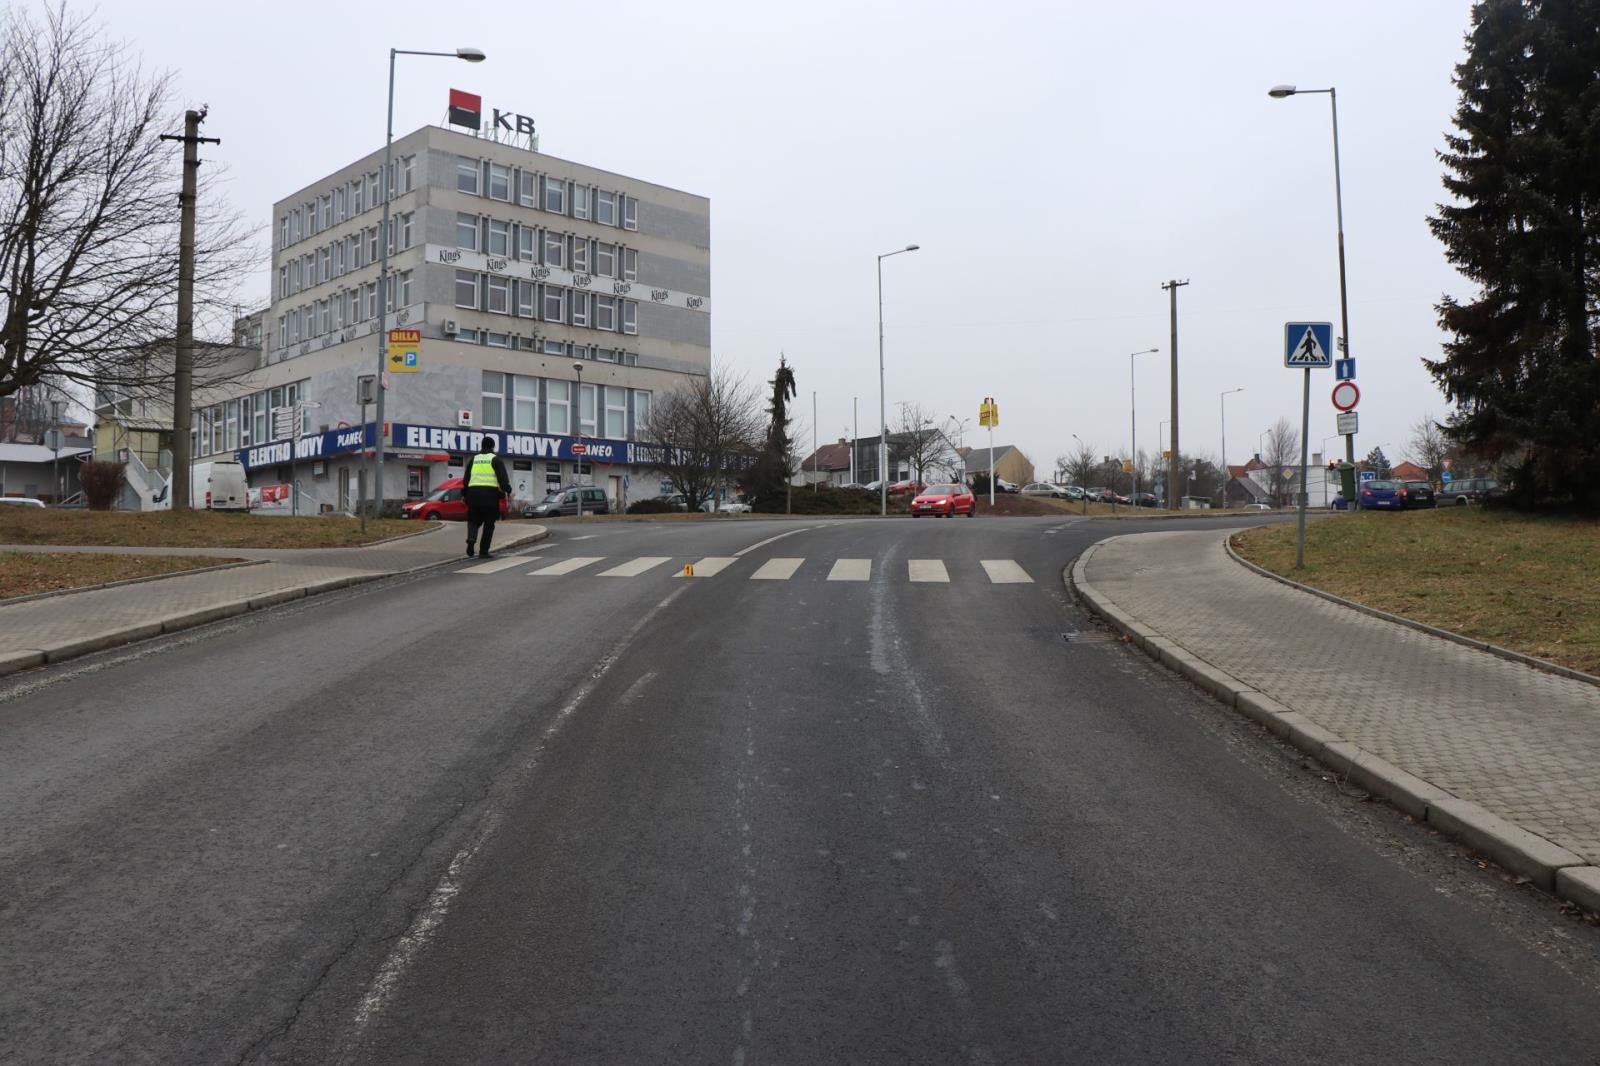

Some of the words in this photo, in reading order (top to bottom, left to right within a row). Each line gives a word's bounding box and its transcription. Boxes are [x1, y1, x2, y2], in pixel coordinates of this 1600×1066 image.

[493, 108, 535, 134] KB
[440, 249, 461, 264] King's
[486, 258, 507, 272] King's
[531, 266, 551, 281] King's
[573, 274, 591, 288] King's
[613, 282, 631, 296] King's
[651, 290, 668, 302] King's
[686, 297, 703, 309] King's
[391, 332, 419, 341] BILLA
[406, 353, 415, 365] P
[406, 426, 499, 453] ELEKTRO
[506, 435, 562, 457] NOVY
[248, 442, 291, 467] ELEKTRO
[294, 434, 325, 459] NOVY
